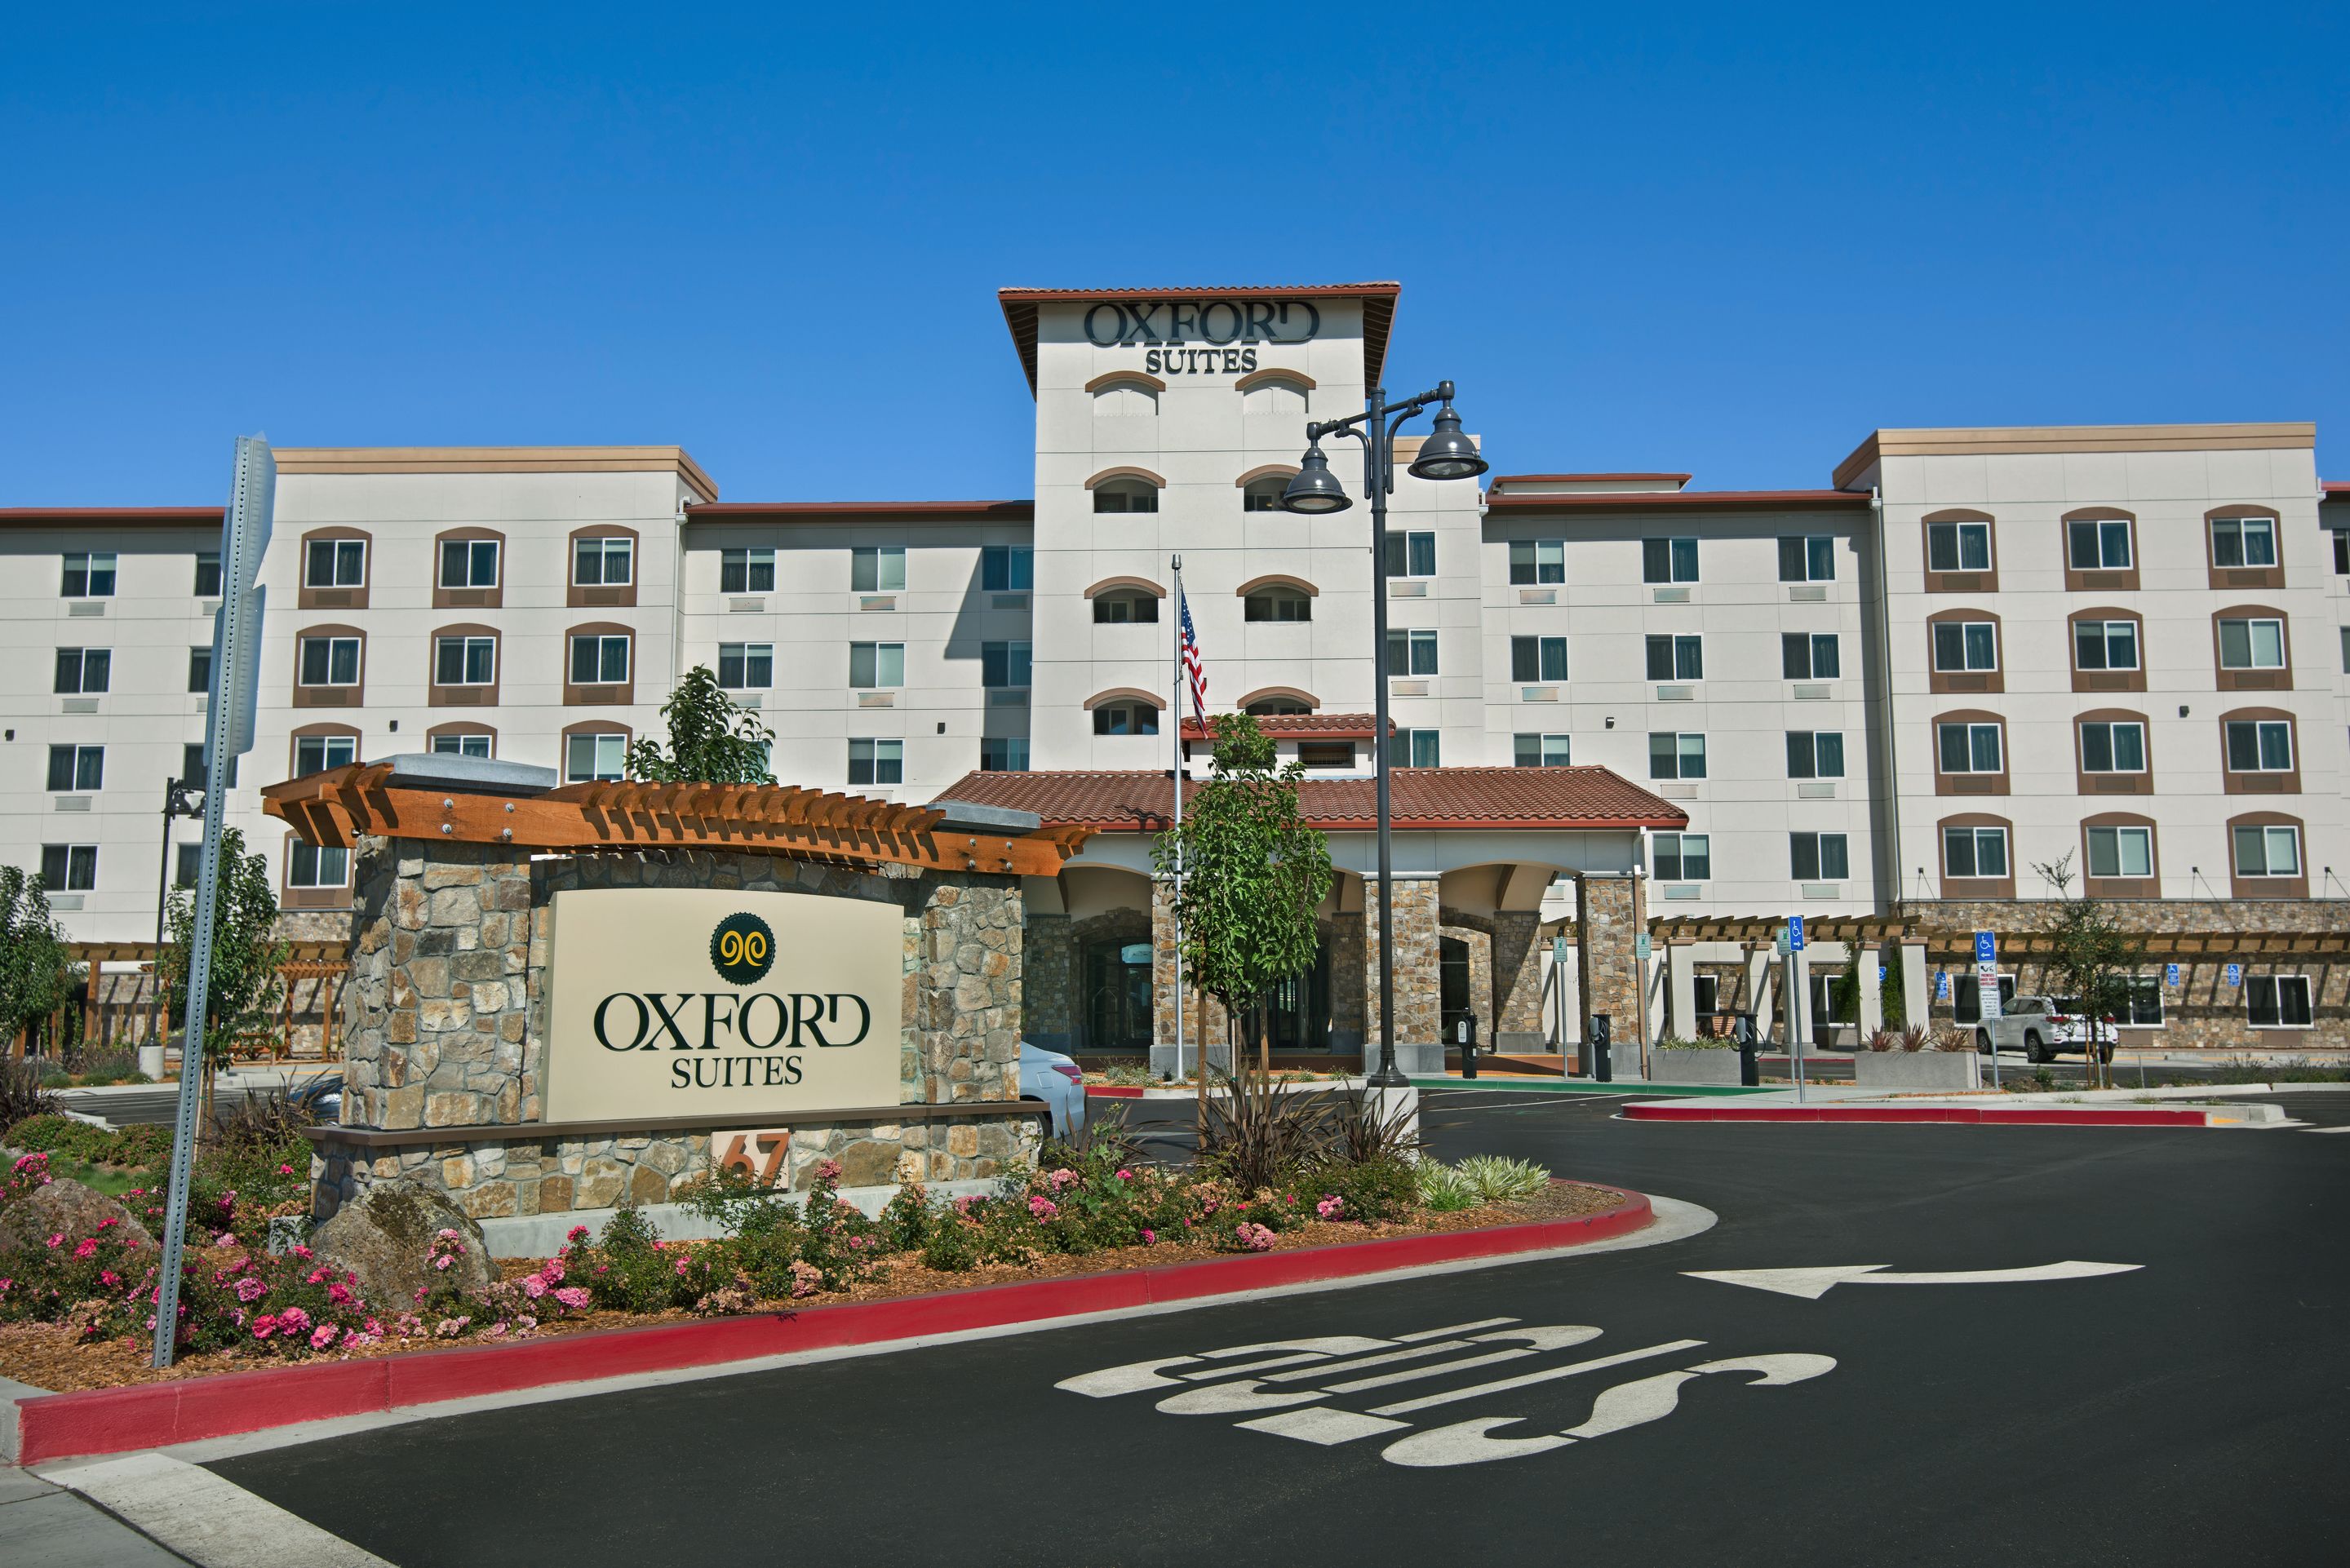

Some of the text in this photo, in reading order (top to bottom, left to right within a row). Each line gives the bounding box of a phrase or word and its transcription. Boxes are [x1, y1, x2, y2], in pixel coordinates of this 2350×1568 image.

[1084, 300, 1320, 347] OXFORD
[1145, 348, 1258, 374] SUITES
[593, 993, 871, 1052] OXFORD
[672, 1055, 803, 1088] SUITES
[721, 1132, 791, 1188] 67
[1053, 1317, 1838, 1467] STOP
